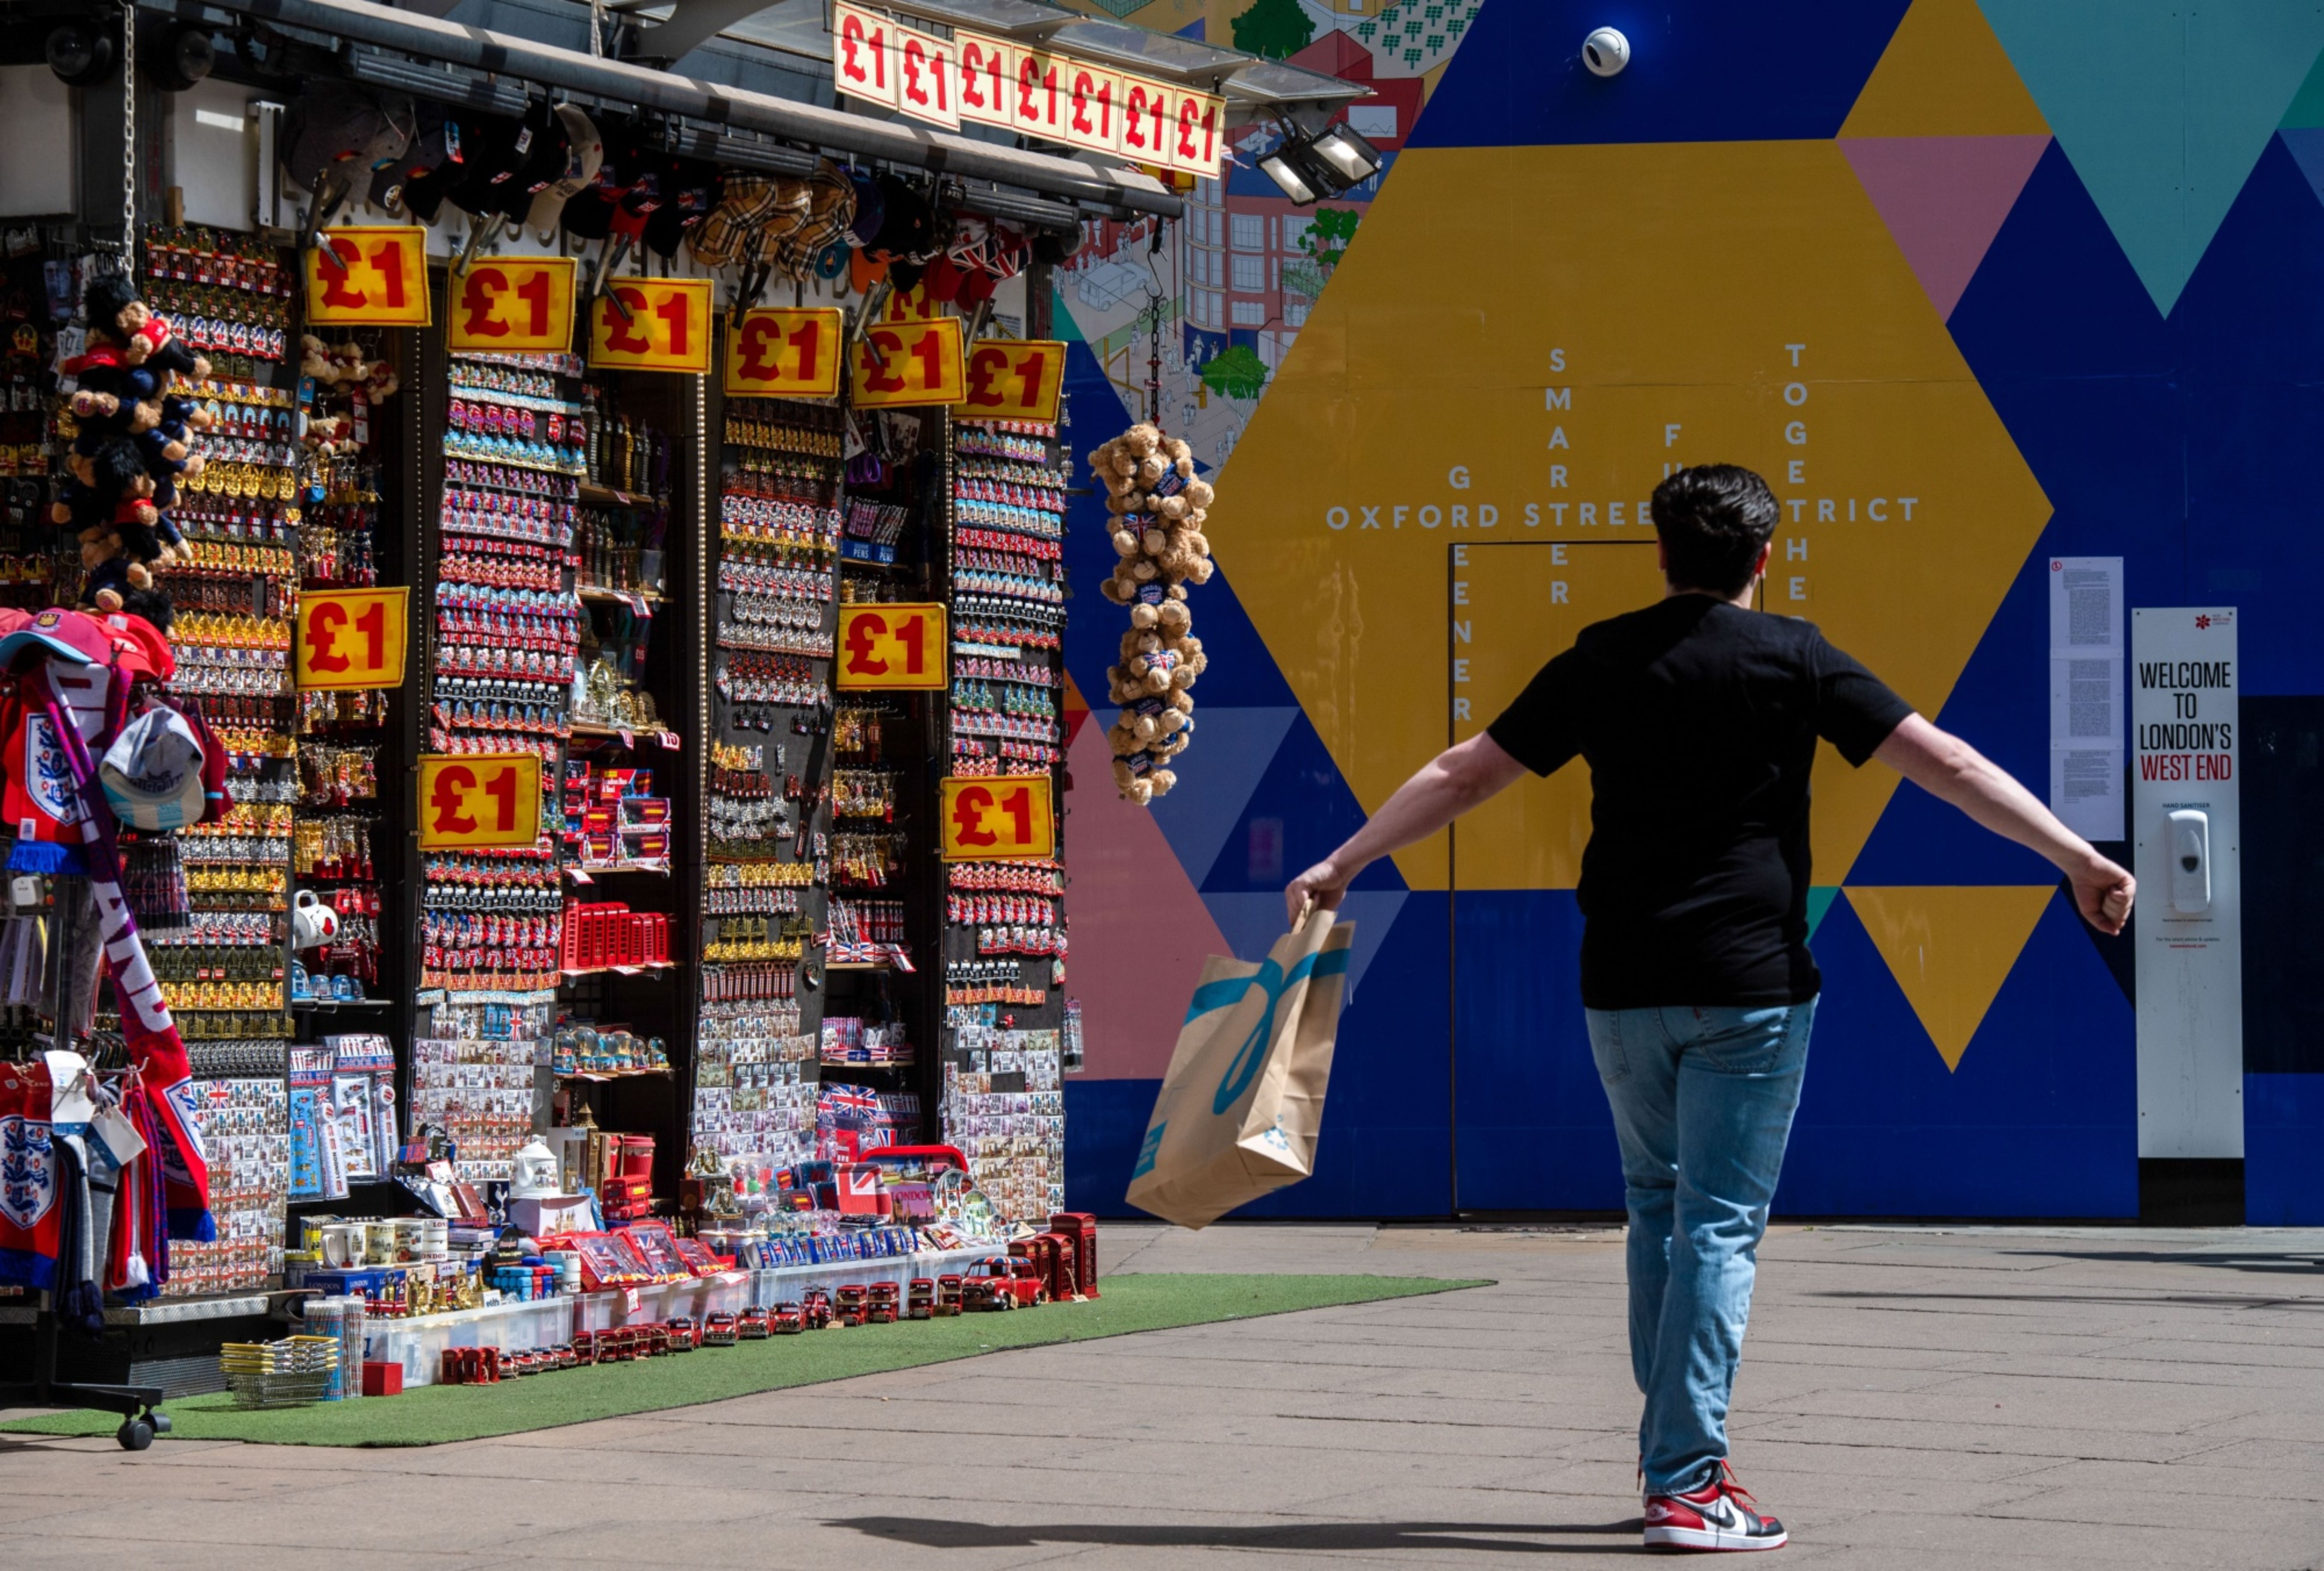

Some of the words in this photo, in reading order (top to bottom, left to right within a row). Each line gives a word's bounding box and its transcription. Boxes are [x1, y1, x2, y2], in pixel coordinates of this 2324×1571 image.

[842, 15, 885, 89] £1
[904, 39, 947, 111] £1
[962, 43, 1002, 111] £1
[1018, 56, 1057, 125] £1
[1072, 71, 1109, 138] £1
[1126, 86, 1164, 151] £1
[1178, 98, 1215, 162] £1
[316, 238, 405, 309] £1
[462, 268, 549, 337] £1
[603, 287, 687, 355] £1
[737, 317, 818, 381] £1
[861, 330, 941, 394] £1
[967, 348, 1044, 407] £1
[1546, 348, 1570, 603] SMARTER
[1784, 344, 1807, 621] TOGETHE
[1326, 504, 1498, 530] OXFORD
[1524, 502, 1652, 526] STREE
[1787, 498, 1918, 522] TRICT
[853, 549, 869, 558] PENS
[880, 552, 893, 561] PENS
[1449, 466, 1471, 720] GREENER
[305, 602, 384, 672] £1
[845, 613, 923, 675] £1
[2139, 662, 2231, 688] WELCOME
[2173, 692, 2197, 719] TO
[2140, 723, 2231, 750] LONDON'S
[2141, 755, 2192, 781] WEST
[2197, 754, 2231, 781] END
[431, 765, 516, 834] £1
[953, 786, 1031, 847] £1
[891, 1191, 933, 1201] LONDON
[350, 1280, 368, 1288] LONDON
